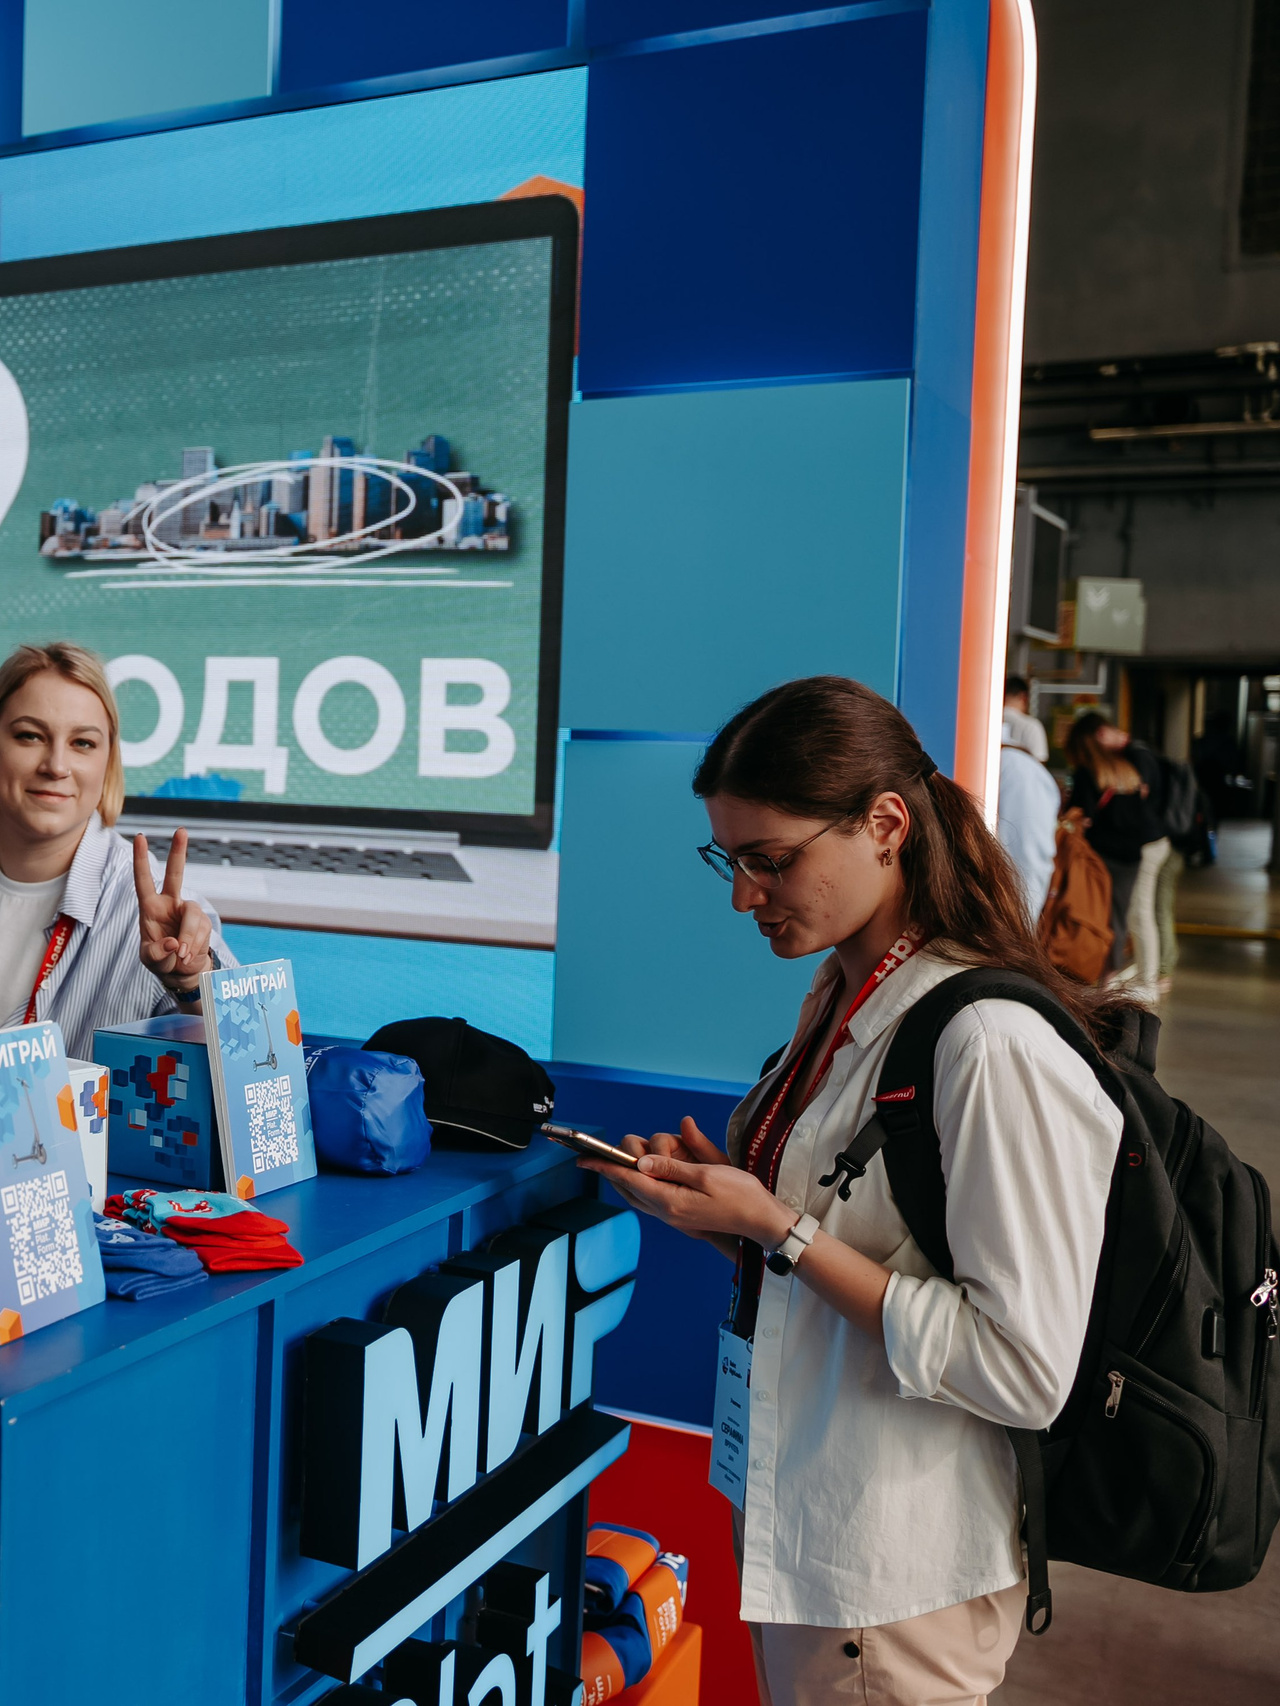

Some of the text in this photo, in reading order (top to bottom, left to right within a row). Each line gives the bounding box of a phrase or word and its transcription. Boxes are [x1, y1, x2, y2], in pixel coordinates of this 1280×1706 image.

[41, 926, 68, 979] hLoad++
[221, 966, 287, 1000] ВЫИГРАЙ
[357, 1210, 642, 1572] МИР
